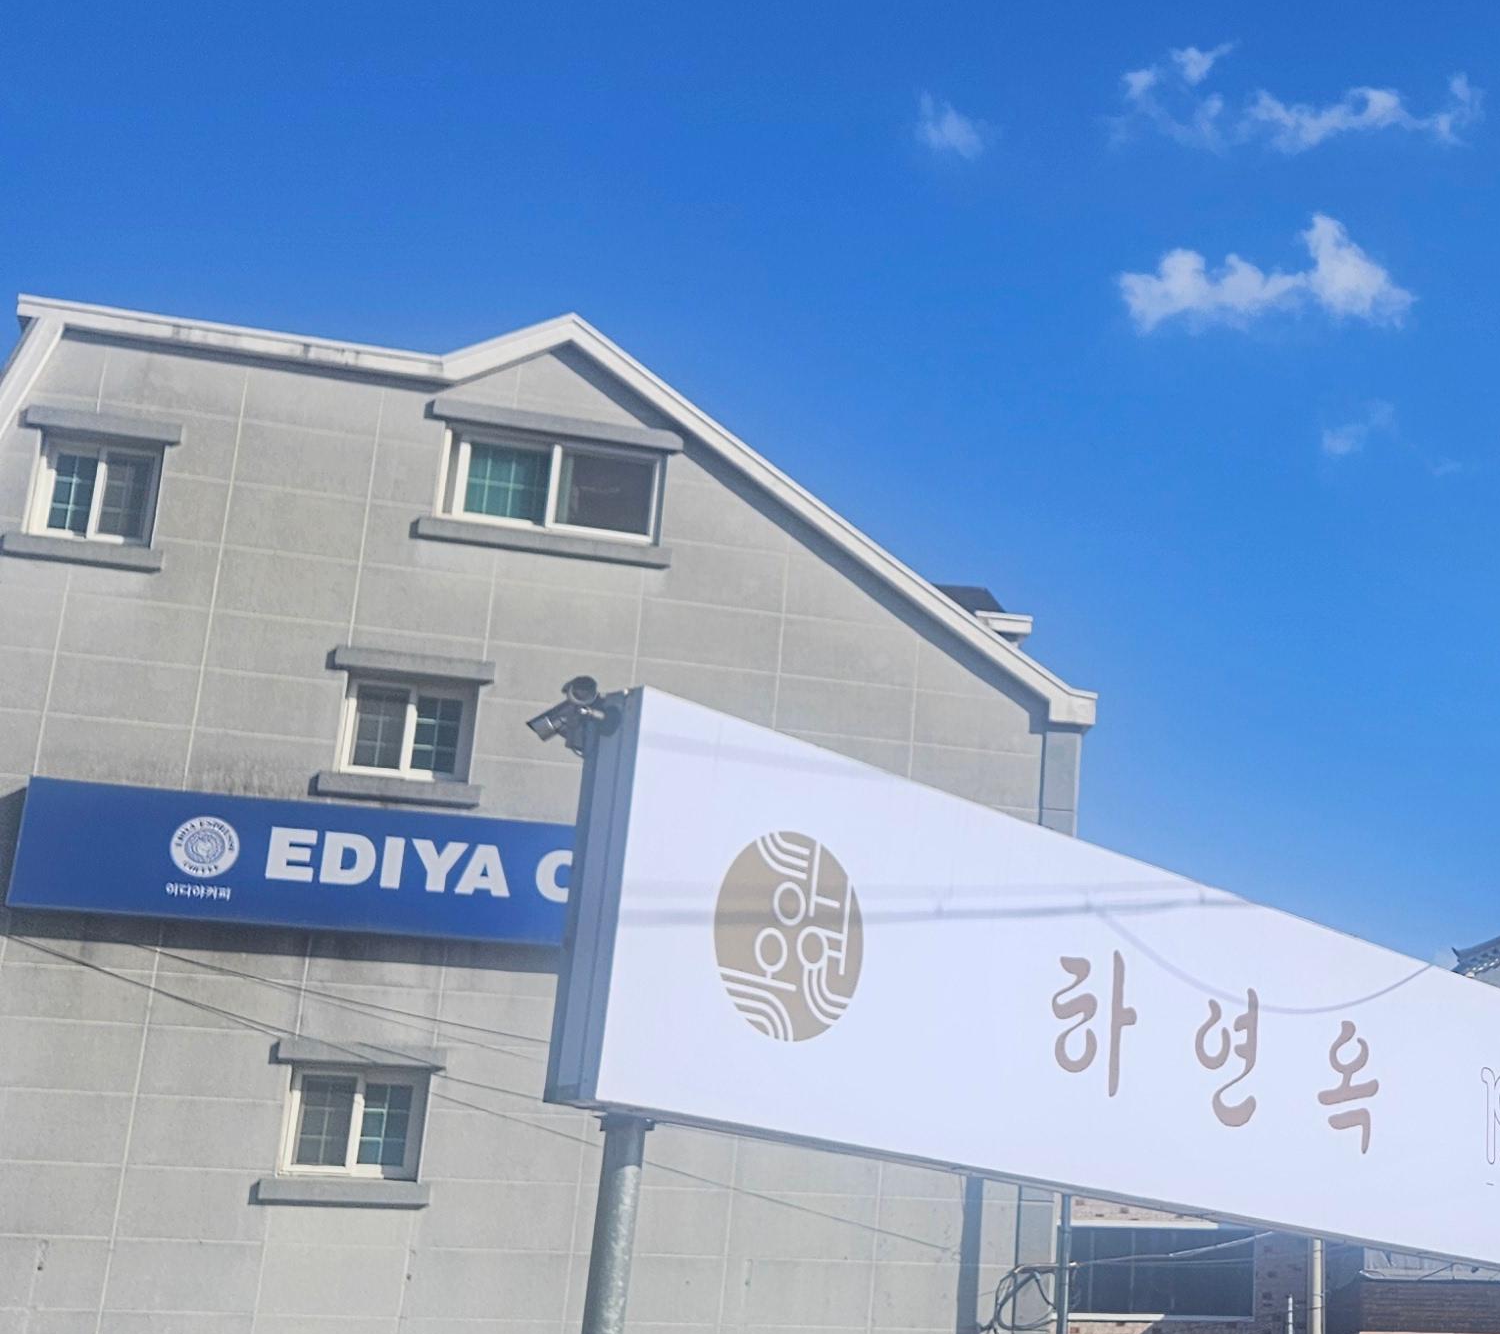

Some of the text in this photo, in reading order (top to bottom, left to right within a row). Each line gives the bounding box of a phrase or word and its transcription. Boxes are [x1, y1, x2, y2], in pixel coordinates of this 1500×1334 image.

[165, 882, 231, 901] 이디야커피
[265, 826, 510, 898] EDIYA
[1052, 949, 1379, 1155] 하연옥
